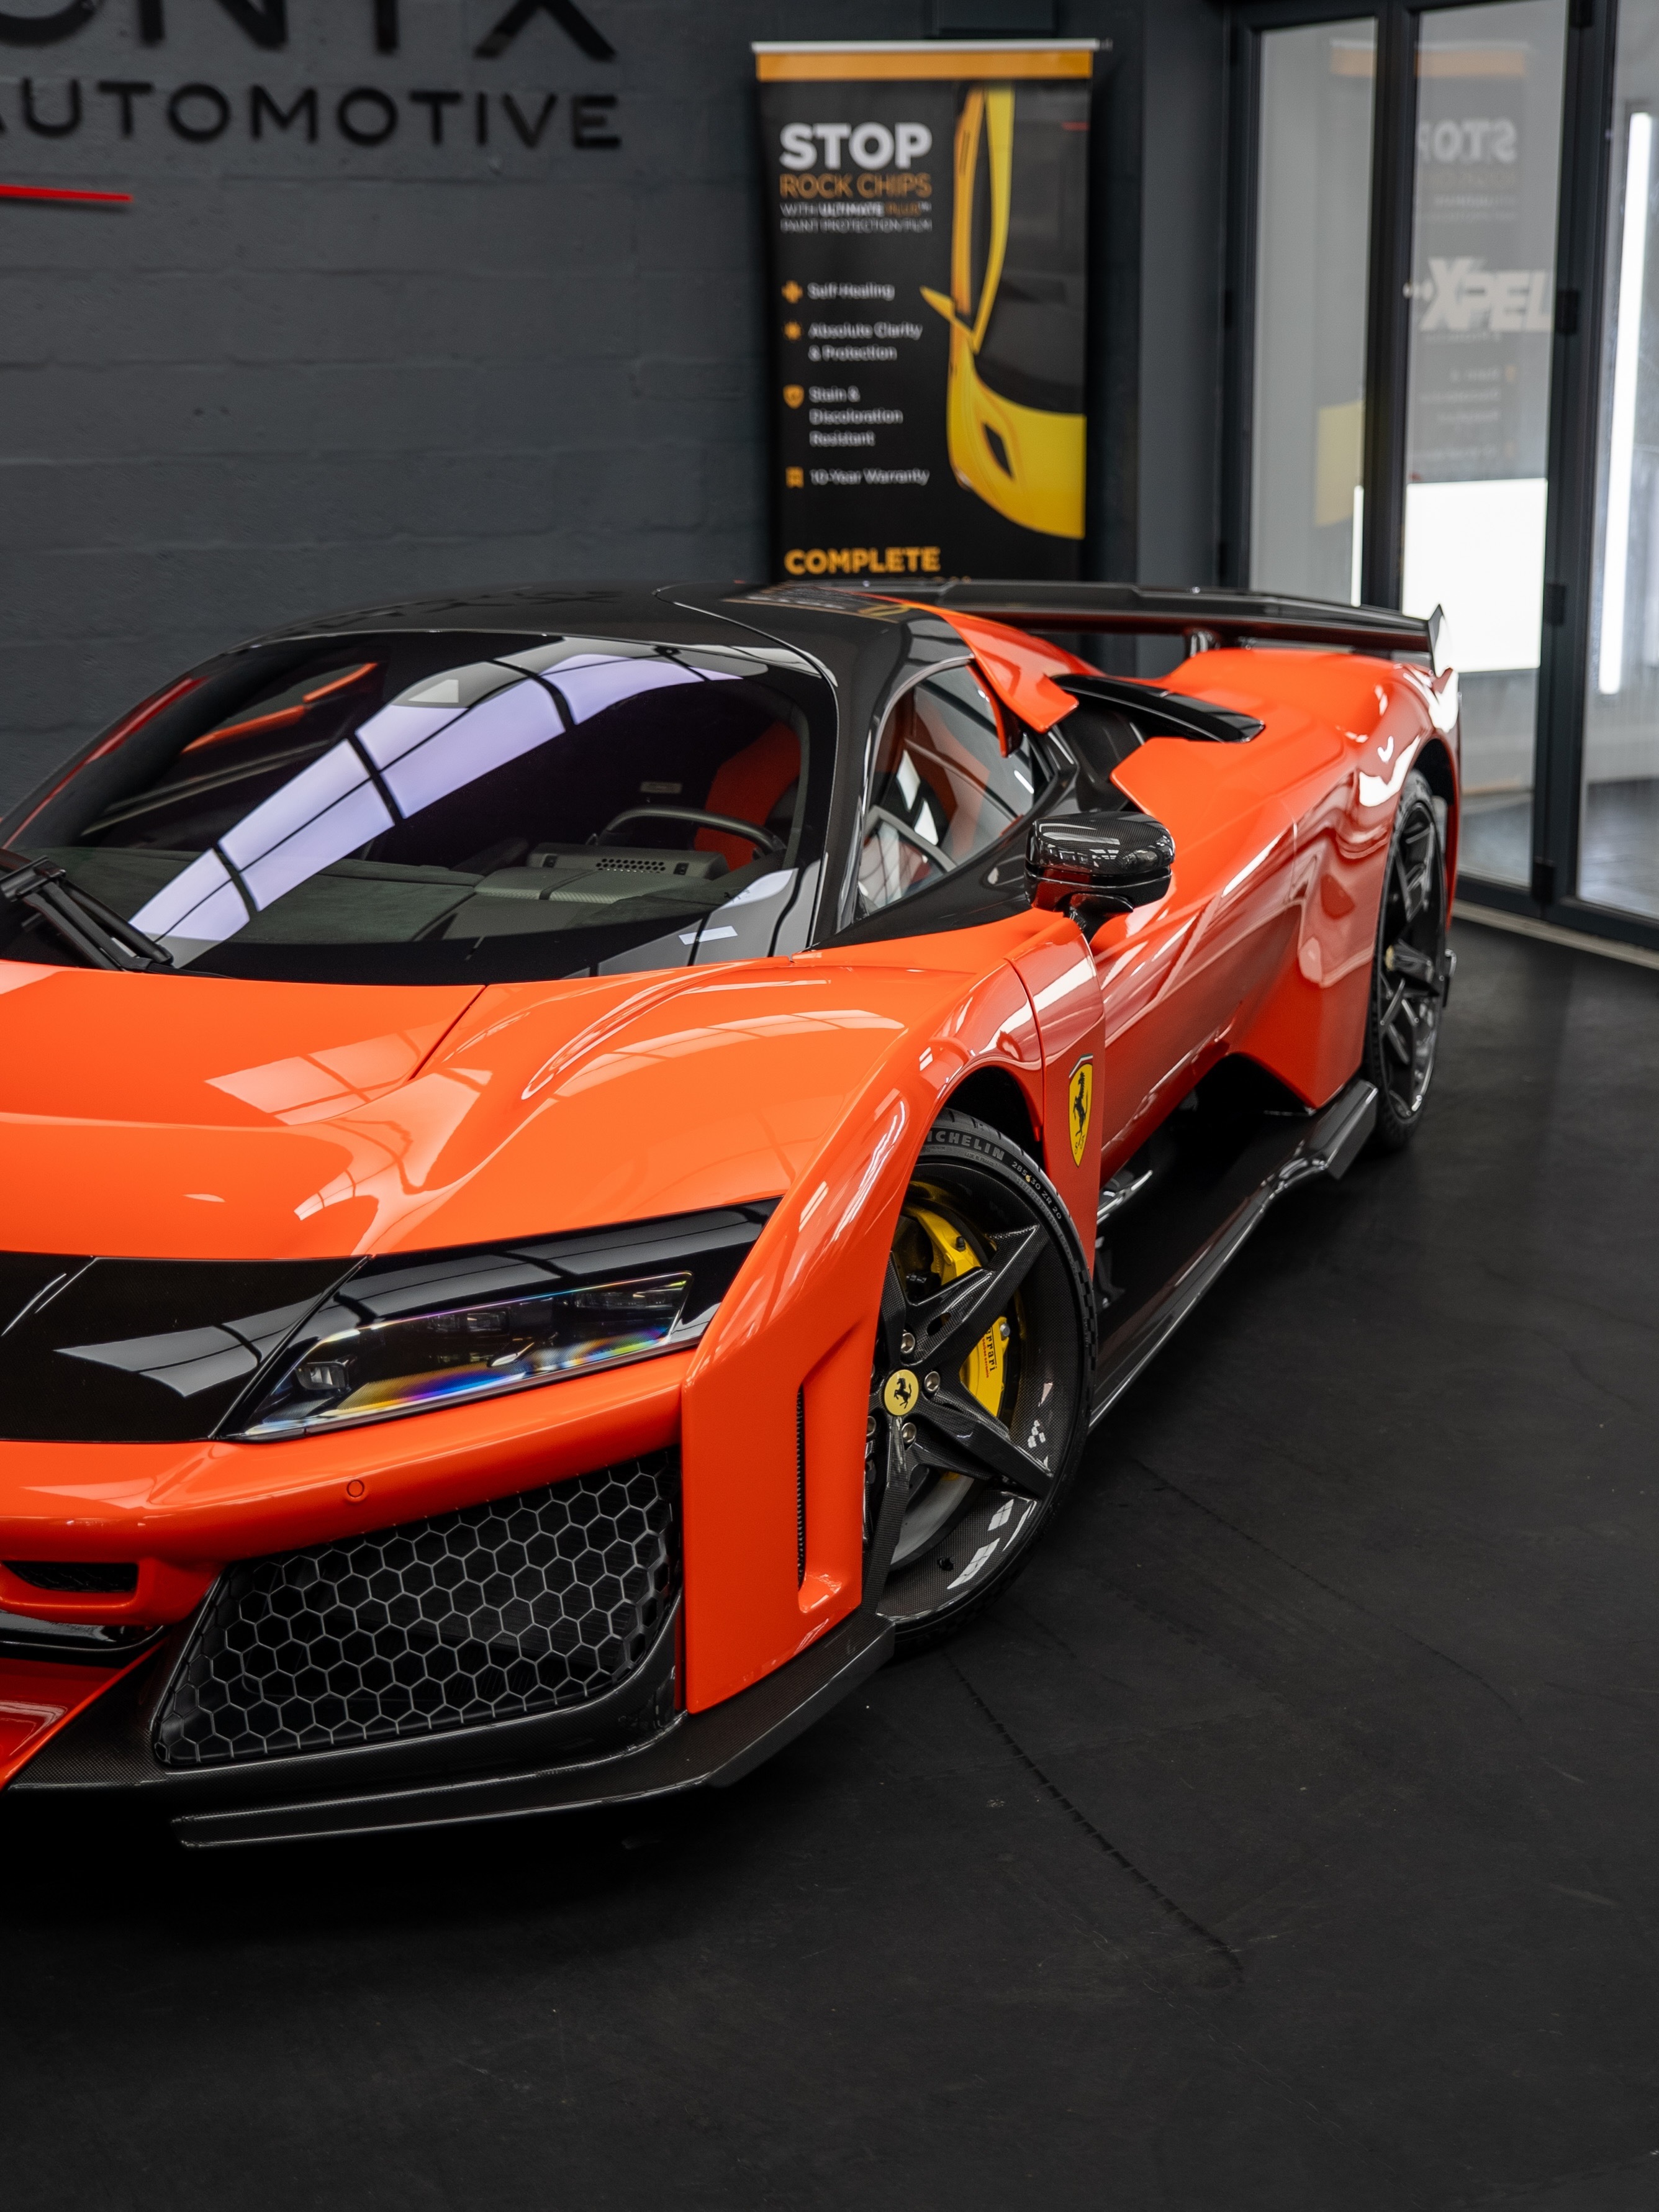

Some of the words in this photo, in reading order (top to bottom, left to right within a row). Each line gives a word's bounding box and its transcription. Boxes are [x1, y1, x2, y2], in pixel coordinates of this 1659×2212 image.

[0, 78, 621, 150] UTOMOTIVE
[779, 122, 933, 170] STOP
[780, 173, 853, 199] ROCK
[856, 172, 932, 199] CHIPS
[808, 322, 873, 339] Absolute
[874, 321, 923, 340] Clarity
[808, 344, 821, 361] &
[822, 344, 897, 361] Protection
[808, 386, 847, 402] Stain
[848, 386, 861, 402] &
[809, 407, 903, 425] Discoloration
[809, 429, 875, 447] Resistant
[862, 468, 930, 486] Warranty
[784, 546, 941, 576] COMPLETE
[927, 1131, 1005, 1161] ICHELIN
[1042, 1190, 1052, 1205] ZR
[1052, 1206, 1062, 1220] 20
[985, 1328, 998, 1372] errari
